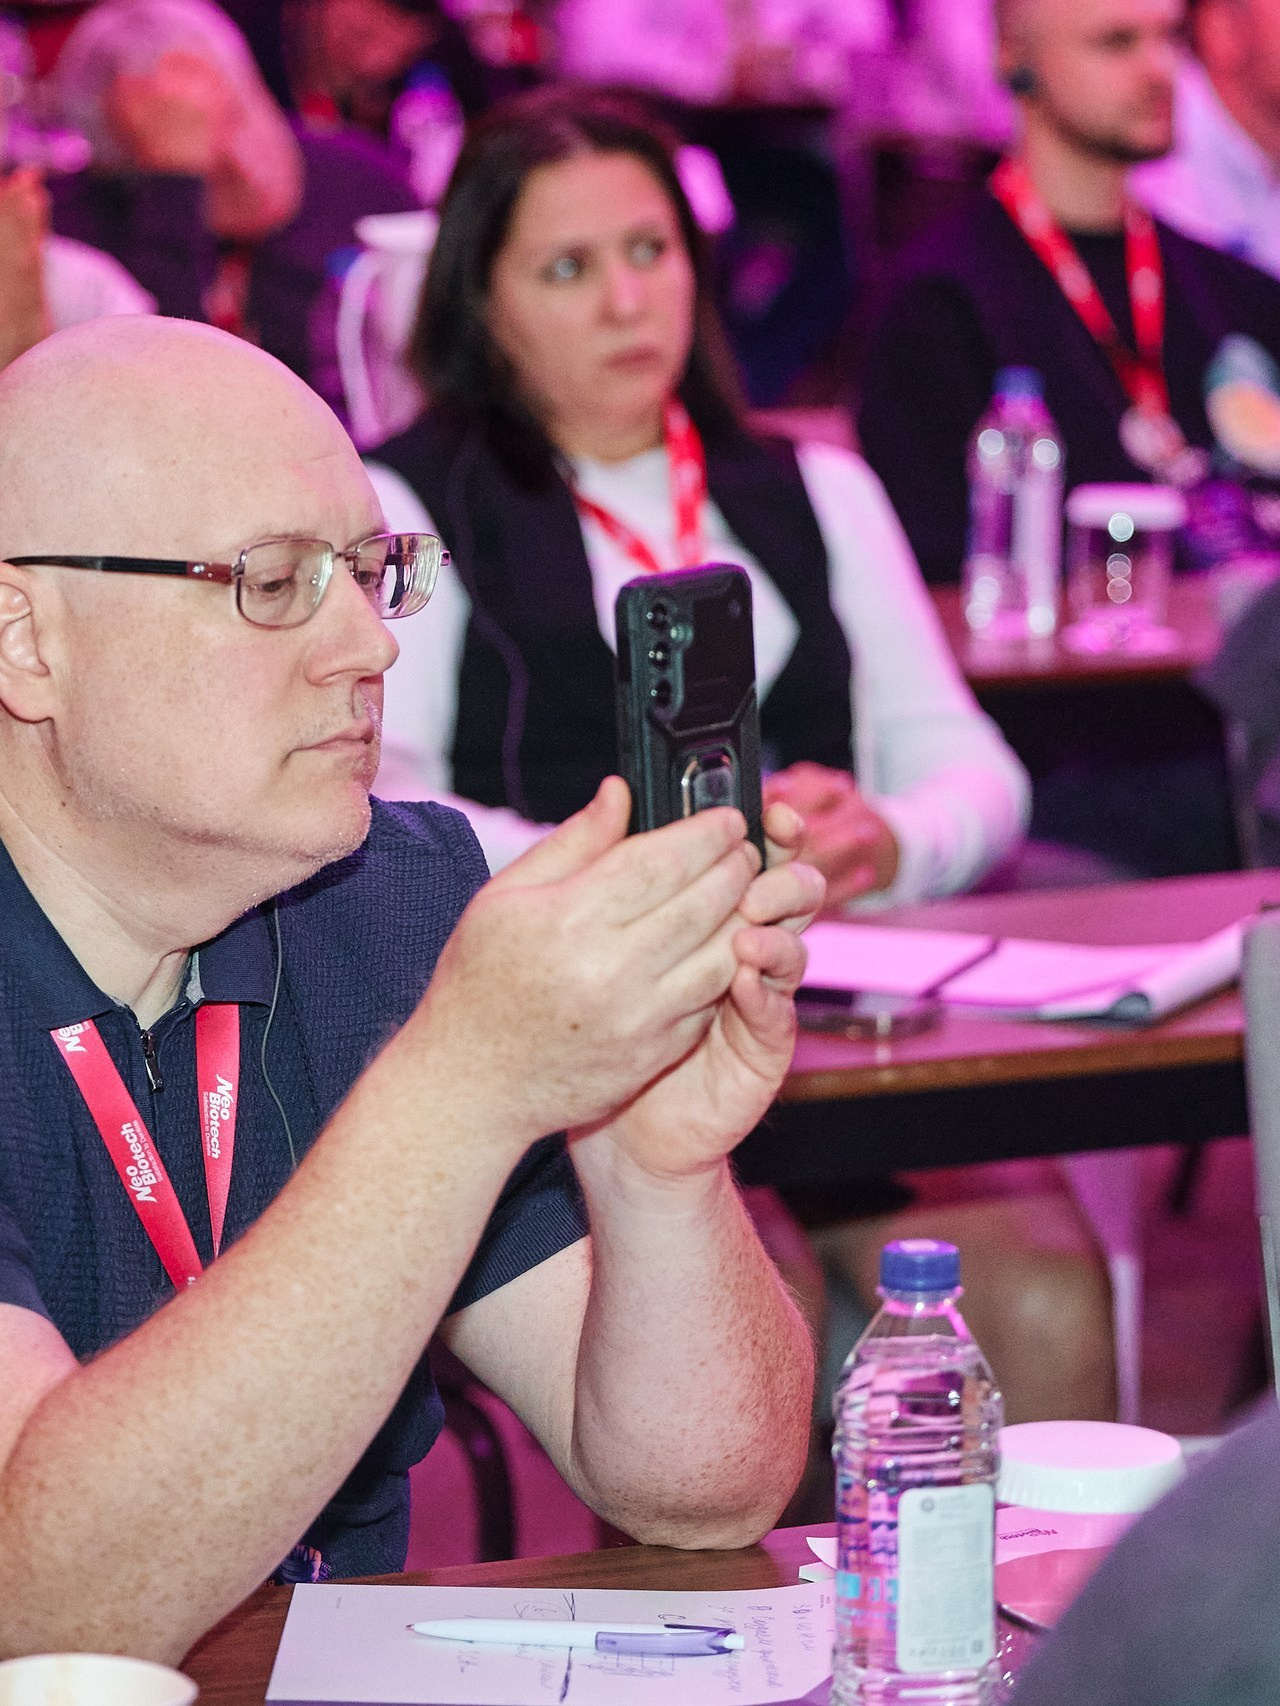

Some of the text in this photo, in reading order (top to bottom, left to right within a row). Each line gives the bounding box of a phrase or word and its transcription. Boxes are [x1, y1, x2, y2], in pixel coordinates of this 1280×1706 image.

[56, 1026, 87, 1052] Ne
[216, 1074, 234, 1120] Neo
[209, 1091, 221, 1159] Biotech
[120, 1122, 157, 1186] Biotech
[125, 1165, 158, 1203] Neo
